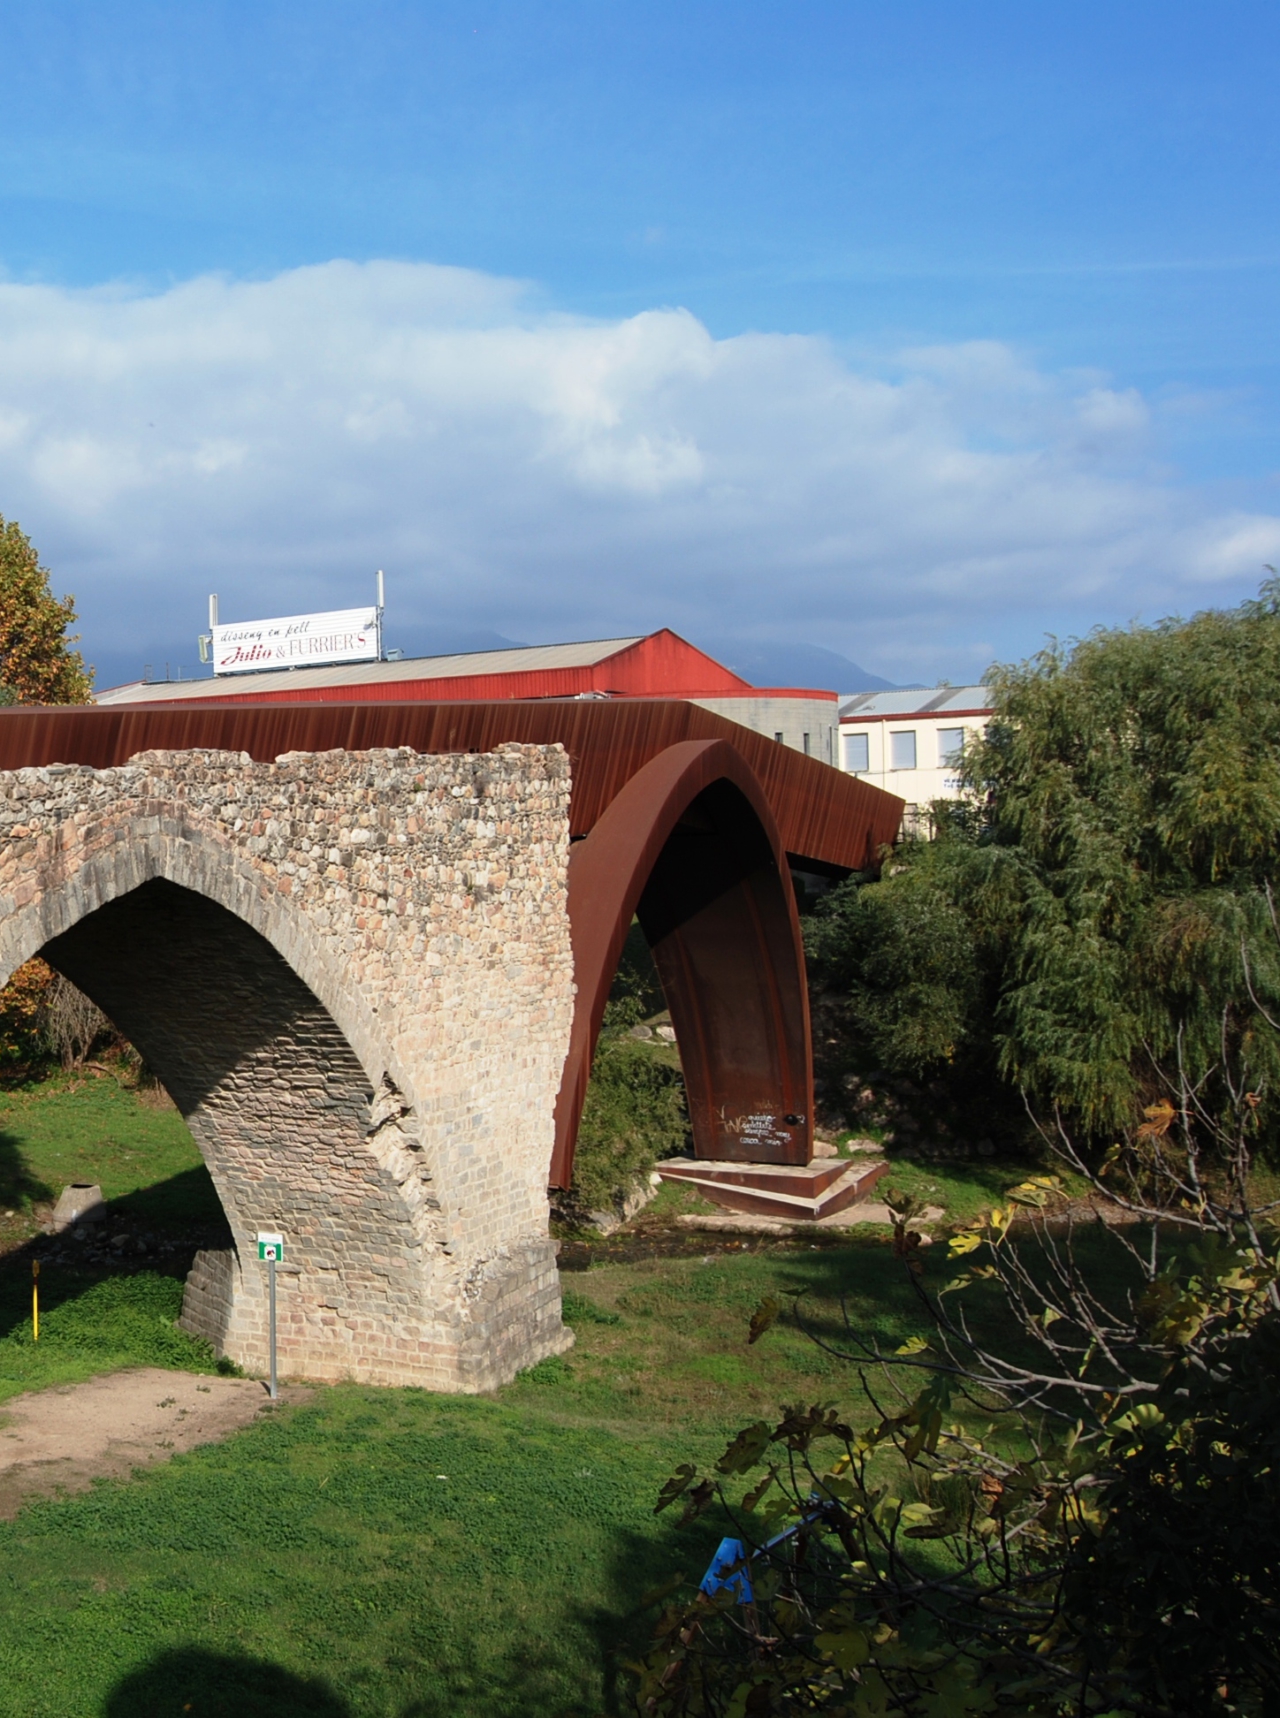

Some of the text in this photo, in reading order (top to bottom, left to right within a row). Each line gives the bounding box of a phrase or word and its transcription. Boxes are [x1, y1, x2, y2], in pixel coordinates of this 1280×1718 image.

[220, 620, 311, 642] disseny en pell
[220, 631, 367, 666] Julio & FURRIER'S
